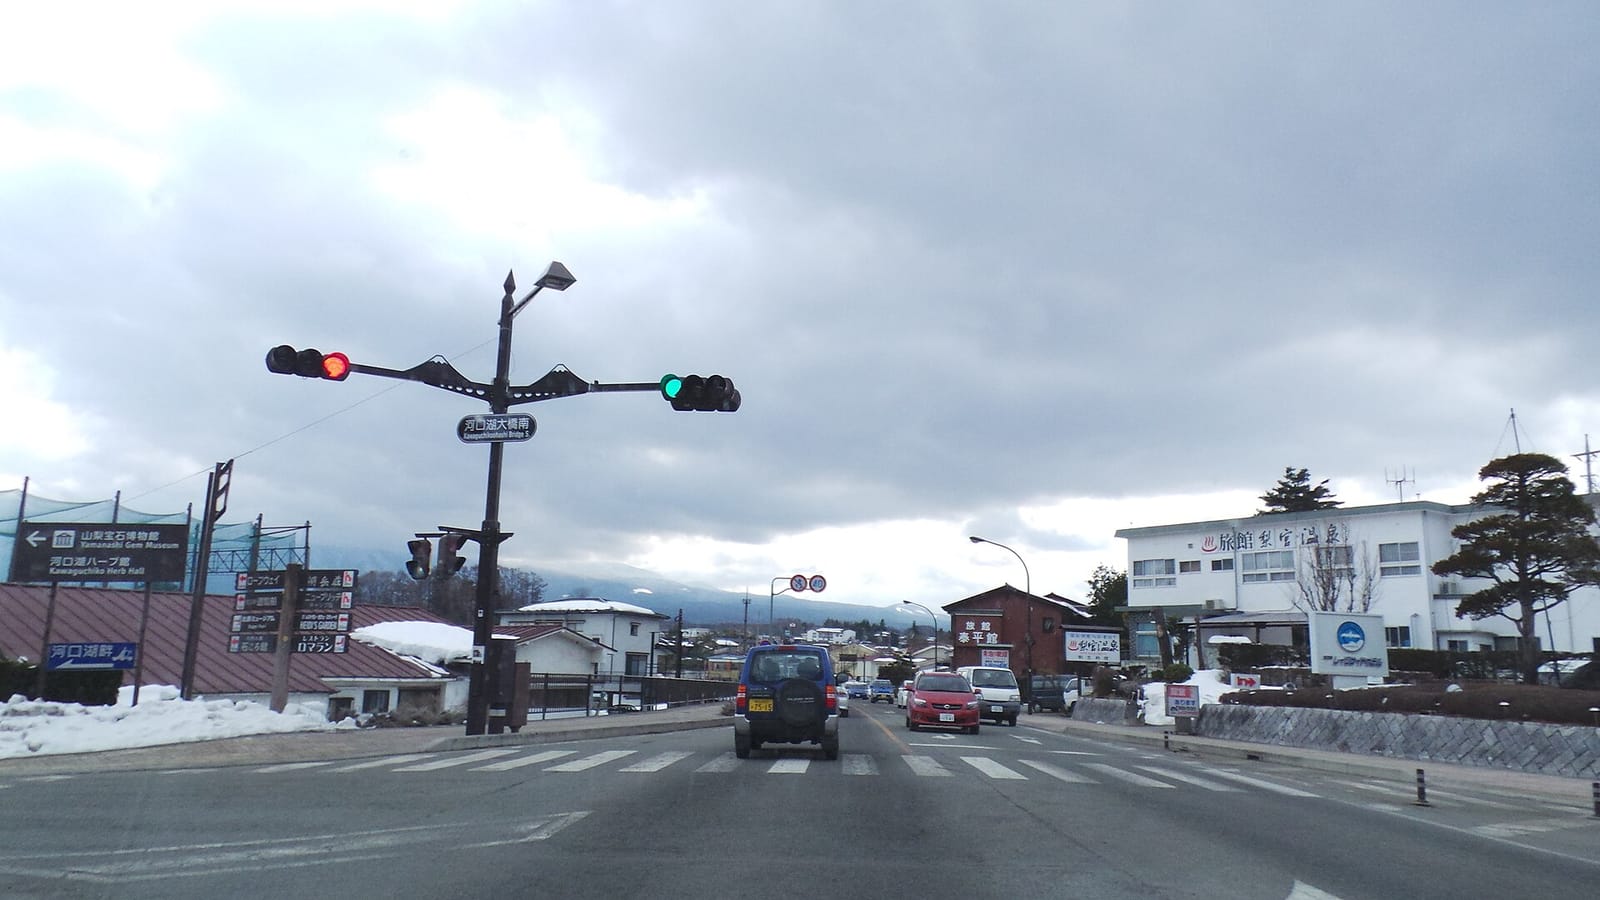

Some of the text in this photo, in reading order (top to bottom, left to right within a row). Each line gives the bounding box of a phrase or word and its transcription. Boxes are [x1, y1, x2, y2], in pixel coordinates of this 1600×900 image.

[464, 417, 529, 432] 河口湖大橋南
[81, 530, 160, 541] 山梨宝石博物館
[80, 541, 123, 549] Yamanashi
[124, 541, 143, 549] Gem
[49, 556, 131, 567] 河口湖ハーブ館
[49, 567, 145, 577] Kawaguchiko Herb Hall
[958, 631, 999, 644] 泰平館
[297, 642, 333, 653] ロマラン
